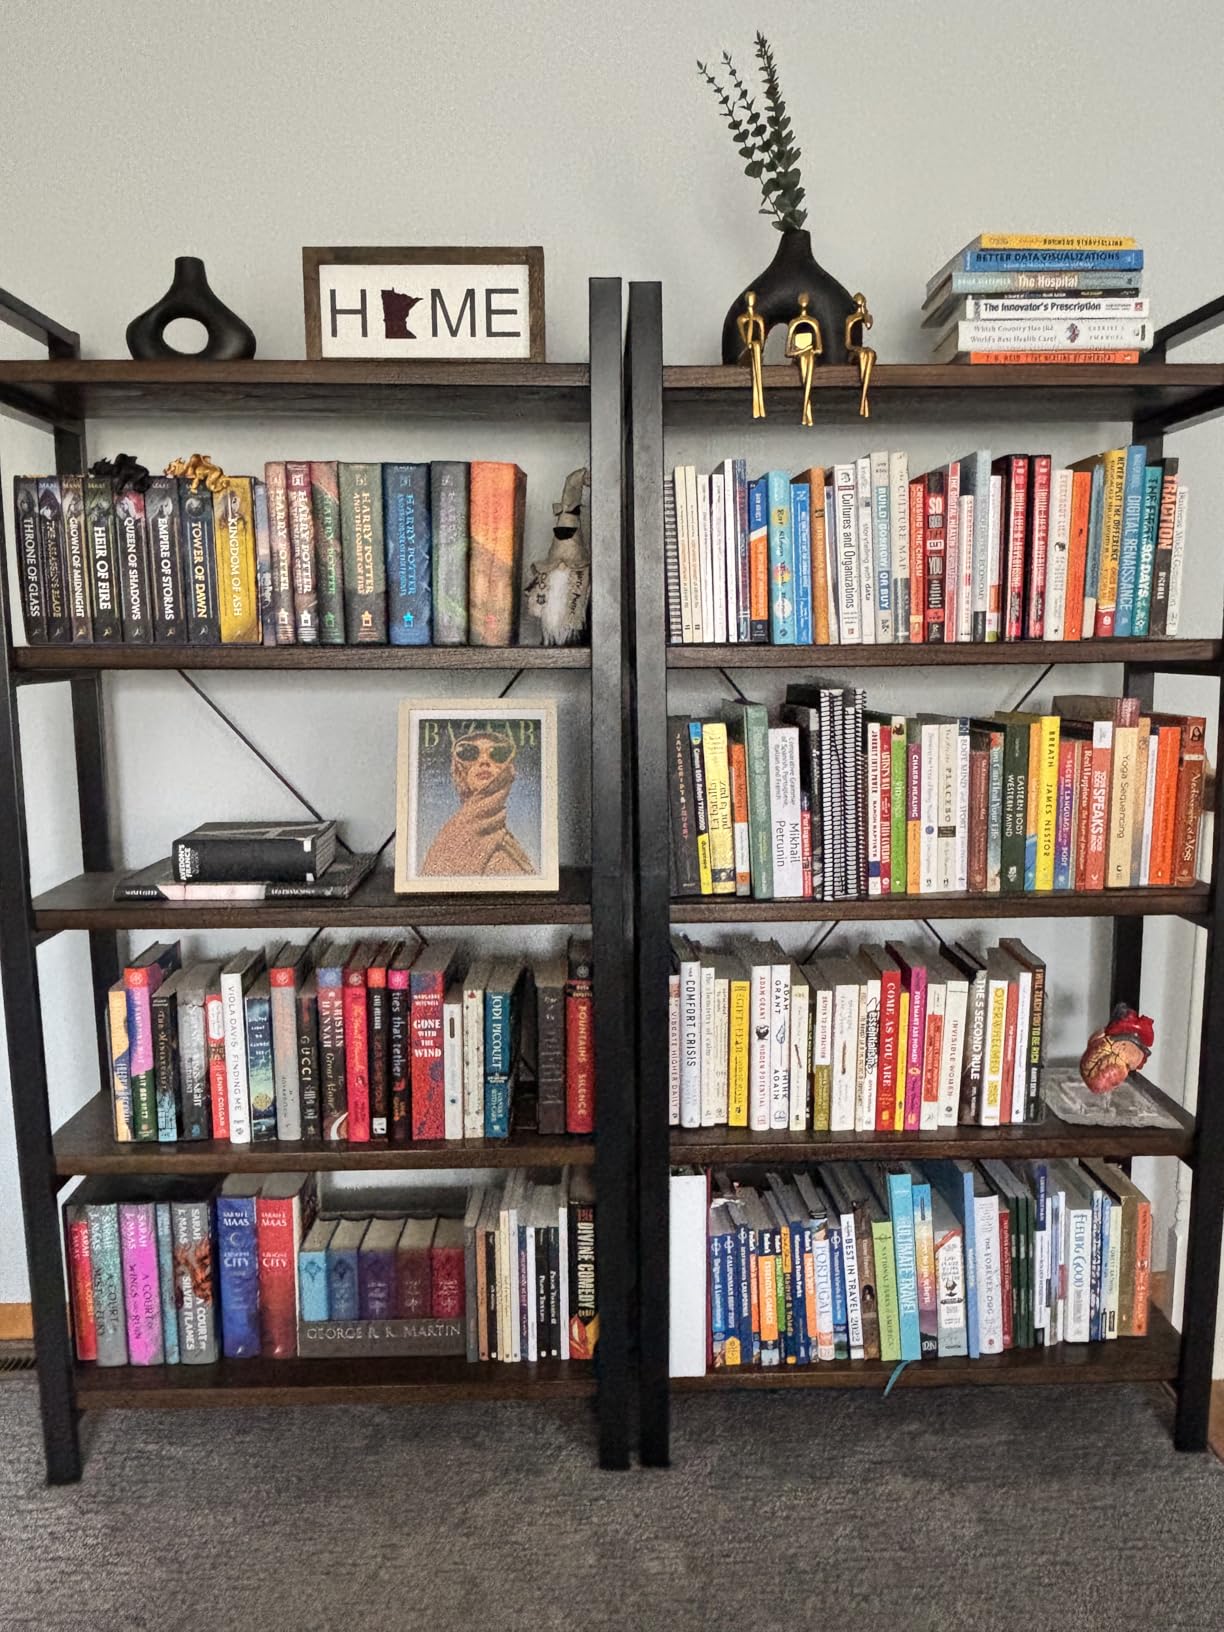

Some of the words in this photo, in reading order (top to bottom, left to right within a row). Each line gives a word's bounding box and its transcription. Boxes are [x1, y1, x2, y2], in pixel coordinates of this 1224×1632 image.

[1018, 275, 1036, 287] The
[1038, 274, 1078, 289] Hospital
[984, 303, 999, 312] The
[1001, 302, 1049, 312] Innovator's
[1050, 302, 1101, 313] Prescription
[1116, 456, 1125, 480] NEVER
[878, 487, 889, 518] BUILD
[915, 486, 924, 527] CROSSING
[928, 497, 943, 515] SO
[1115, 481, 1124, 502] SPLIT
[276, 488, 287, 539] HARRY
[297, 490, 308, 542] HARRY
[362, 492, 373, 543] HARRY
[405, 494, 416, 544] HARRY
[841, 493, 854, 530] Cultures
[1114, 503, 1122, 518] THE
[1125, 495, 1142, 536] DIGITAL
[1157, 473, 1178, 550] TRACTION
[23, 517, 37, 565] THRONE
[69, 516, 82, 554] CROWN
[93, 526, 106, 559] HEIR
[124, 516, 137, 553] QUEEN
[158, 517, 170, 558] EMPIRE
[191, 521, 203, 564] TOWER
[228, 517, 240, 576] KINGDOM
[842, 531, 854, 548] and
[878, 523, 889, 568] BORROW
[915, 529, 924, 548] THE
[1110, 519, 1122, 562] DIFFERENCE
[27, 566, 38, 582] OF
[72, 555, 82, 568] OF
[97, 560, 108, 580] OF
[128, 554, 137, 568] OF
[161, 559, 172, 575] OF
[195, 565, 205, 581] OF
[279, 543, 289, 592] POTTER
[301, 544, 312, 594] POTTER
[364, 545, 374, 594] POTTER
[407, 546, 417, 595] POTTER
[915, 548, 924, 577] CHASM
[928, 556, 943, 575] YOU
[1119, 538, 1139, 611] RENAISSANCE
[72, 569, 85, 618] MIDNIGHT
[98, 581, 112, 610] FIRE
[129, 569, 142, 620] SHADOWS
[232, 577, 241, 592] OF
[843, 550, 857, 609] Organizations
[879, 572, 889, 586] OR
[29, 583, 40, 617] GLASS
[162, 575, 175, 620] STORMS
[196, 583, 207, 618] DAWN
[233, 594, 243, 616] ASH
[879, 588, 890, 609] BUY
[774, 744, 782, 765] Italian
[787, 737, 797, 776] Comparative
[1047, 730, 1056, 768] BREATH
[1084, 750, 1093, 766] Real
[1120, 753, 1130, 779] Yoga
[774, 766, 782, 778] and
[911, 754, 920, 785] CHAKRA
[1065, 759, 1074, 788] SECRET
[775, 779, 783, 800] French
[789, 777, 797, 805] Grammar
[911, 786, 919, 818] HEALING
[944, 767, 952, 823] PLACEBO
[1006, 775, 1015, 811] WESTERN
[1016, 775, 1025, 811] EASTERN
[1045, 784, 1054, 815] JAMES
[1081, 767, 1093, 807] Happiness
[1005, 813, 1014, 838] MIND
[1015, 812, 1024, 836] BODY
[1063, 790, 1073, 832] LANGUAGE
[1090, 788, 1106, 834] SPEAKS
[1116, 782, 1129, 839] Sequencing
[775, 820, 787, 867] Petrunin
[789, 823, 800, 864] Mikhail
[802, 813, 811, 856] Portuguese
[1043, 819, 1053, 857] NESTOR
[1061, 846, 1070, 866] BODY
[228, 986, 236, 1016] VIOLA
[391, 992, 401, 1012] ties
[886, 982, 896, 1016] COME
[976, 978, 985, 1000] THE
[157, 1010, 167, 1029] THE
[322, 1000, 332, 1048] HANNAH
[333, 1000, 344, 1048] KRISTIN
[413, 1018, 442, 1030] GONE
[491, 995, 503, 1020] JODI
[230, 1018, 239, 1047] DAVIS
[392, 1016, 406, 1040] that
[578, 1005, 588, 1063] FOUNTAINS
[866, 1011, 879, 1067] essentialism
[885, 1018, 895, 1034] AS
[949, 1019, 959, 1062] INVISIBLE
[972, 1010, 984, 1052] SECOND
[988, 988, 1006, 1075] OVERWHELMED
[158, 1031, 168, 1090] MINIATURIST
[300, 1035, 312, 1081] GUCCI
[391, 1043, 405, 1077] tether
[414, 1048, 442, 1058] WIND
[491, 1023, 502, 1070] PICOULT
[884, 1037, 894, 1061] YOU
[216, 1072, 224, 1095] JENNY
[231, 1054, 241, 1095] FINDING
[882, 1063, 893, 1087] ARE
[947, 1065, 957, 1098] WOMEN
[970, 1053, 981, 1080] RULE
[235, 1098, 242, 1111] ME
[577, 1073, 588, 1116] SILENCE
[671, 1084, 679, 1108] DAILY
[137, 1214, 147, 1248] SARAH
[190, 1209, 201, 1241] SARAH
[223, 1218, 250, 1226] MAAS
[1073, 1214, 1088, 1254] FEELING
[81, 1229, 90, 1258] SARAH
[577, 1222, 595, 1261] DIVINE
[845, 1237, 854, 1261] BEST
[896, 1225, 914, 1276] ULTIMATE
[142, 1273, 150, 1281] A
[224, 1258, 249, 1268] CITY
[262, 1257, 288, 1268] CITY
[847, 1264, 855, 1275] IN
[1072, 1255, 1088, 1289] GOOD
[129, 1263, 140, 1299] WINGS
[181, 1276, 193, 1309] SILVER
[577, 1263, 595, 1309] COMEDY
[815, 1245, 829, 1316] PORTUGAL
[847, 1279, 858, 1314] TRAVEL
[901, 1277, 916, 1315] TRAVEL
[108, 1285, 119, 1322] COURT
[143, 1284, 154, 1320] COURT
[131, 1314, 142, 1340] RUIN
[184, 1311, 195, 1350] FLAMES
[850, 1316, 861, 1342] 2022
